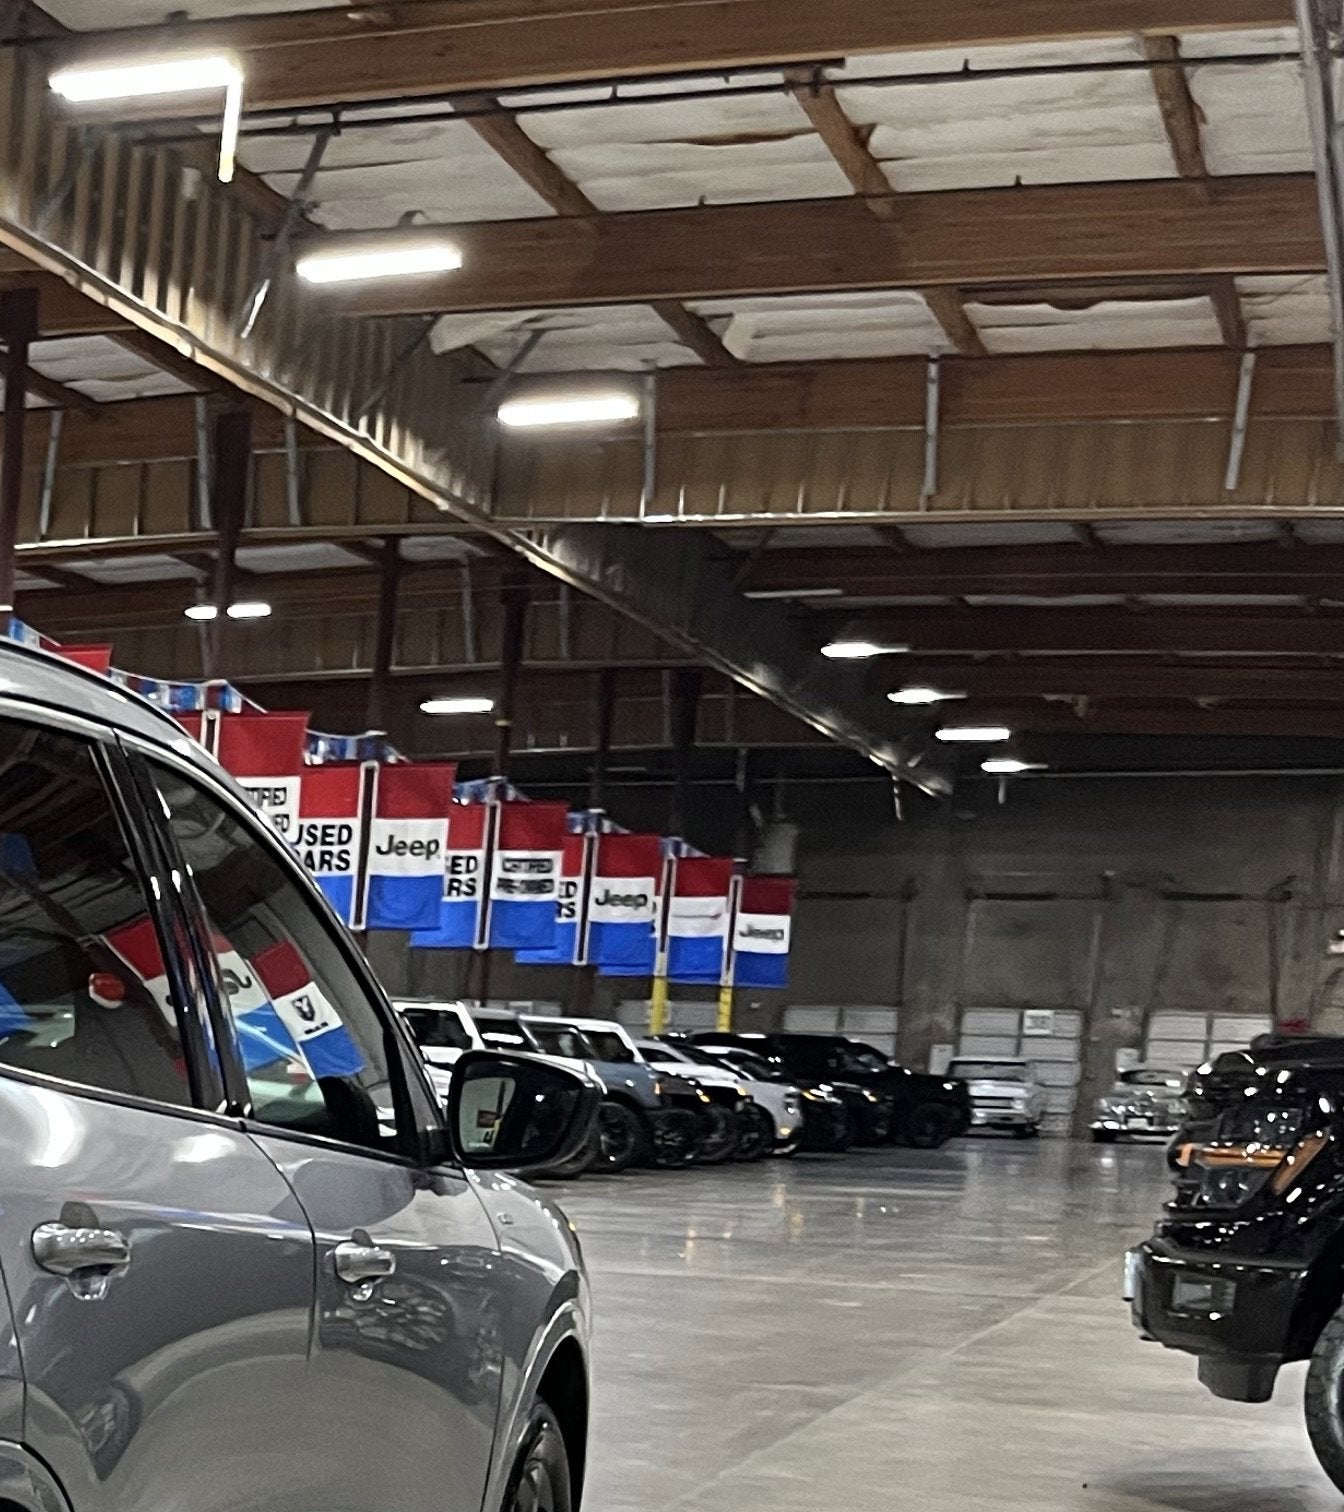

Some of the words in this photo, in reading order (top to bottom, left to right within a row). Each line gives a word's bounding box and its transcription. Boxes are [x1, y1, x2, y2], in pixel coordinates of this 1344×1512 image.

[375, 834, 440, 860] Jeep
[294, 849, 351, 872] ARS
[446, 855, 479, 875] ED
[595, 889, 649, 911] Jeep
